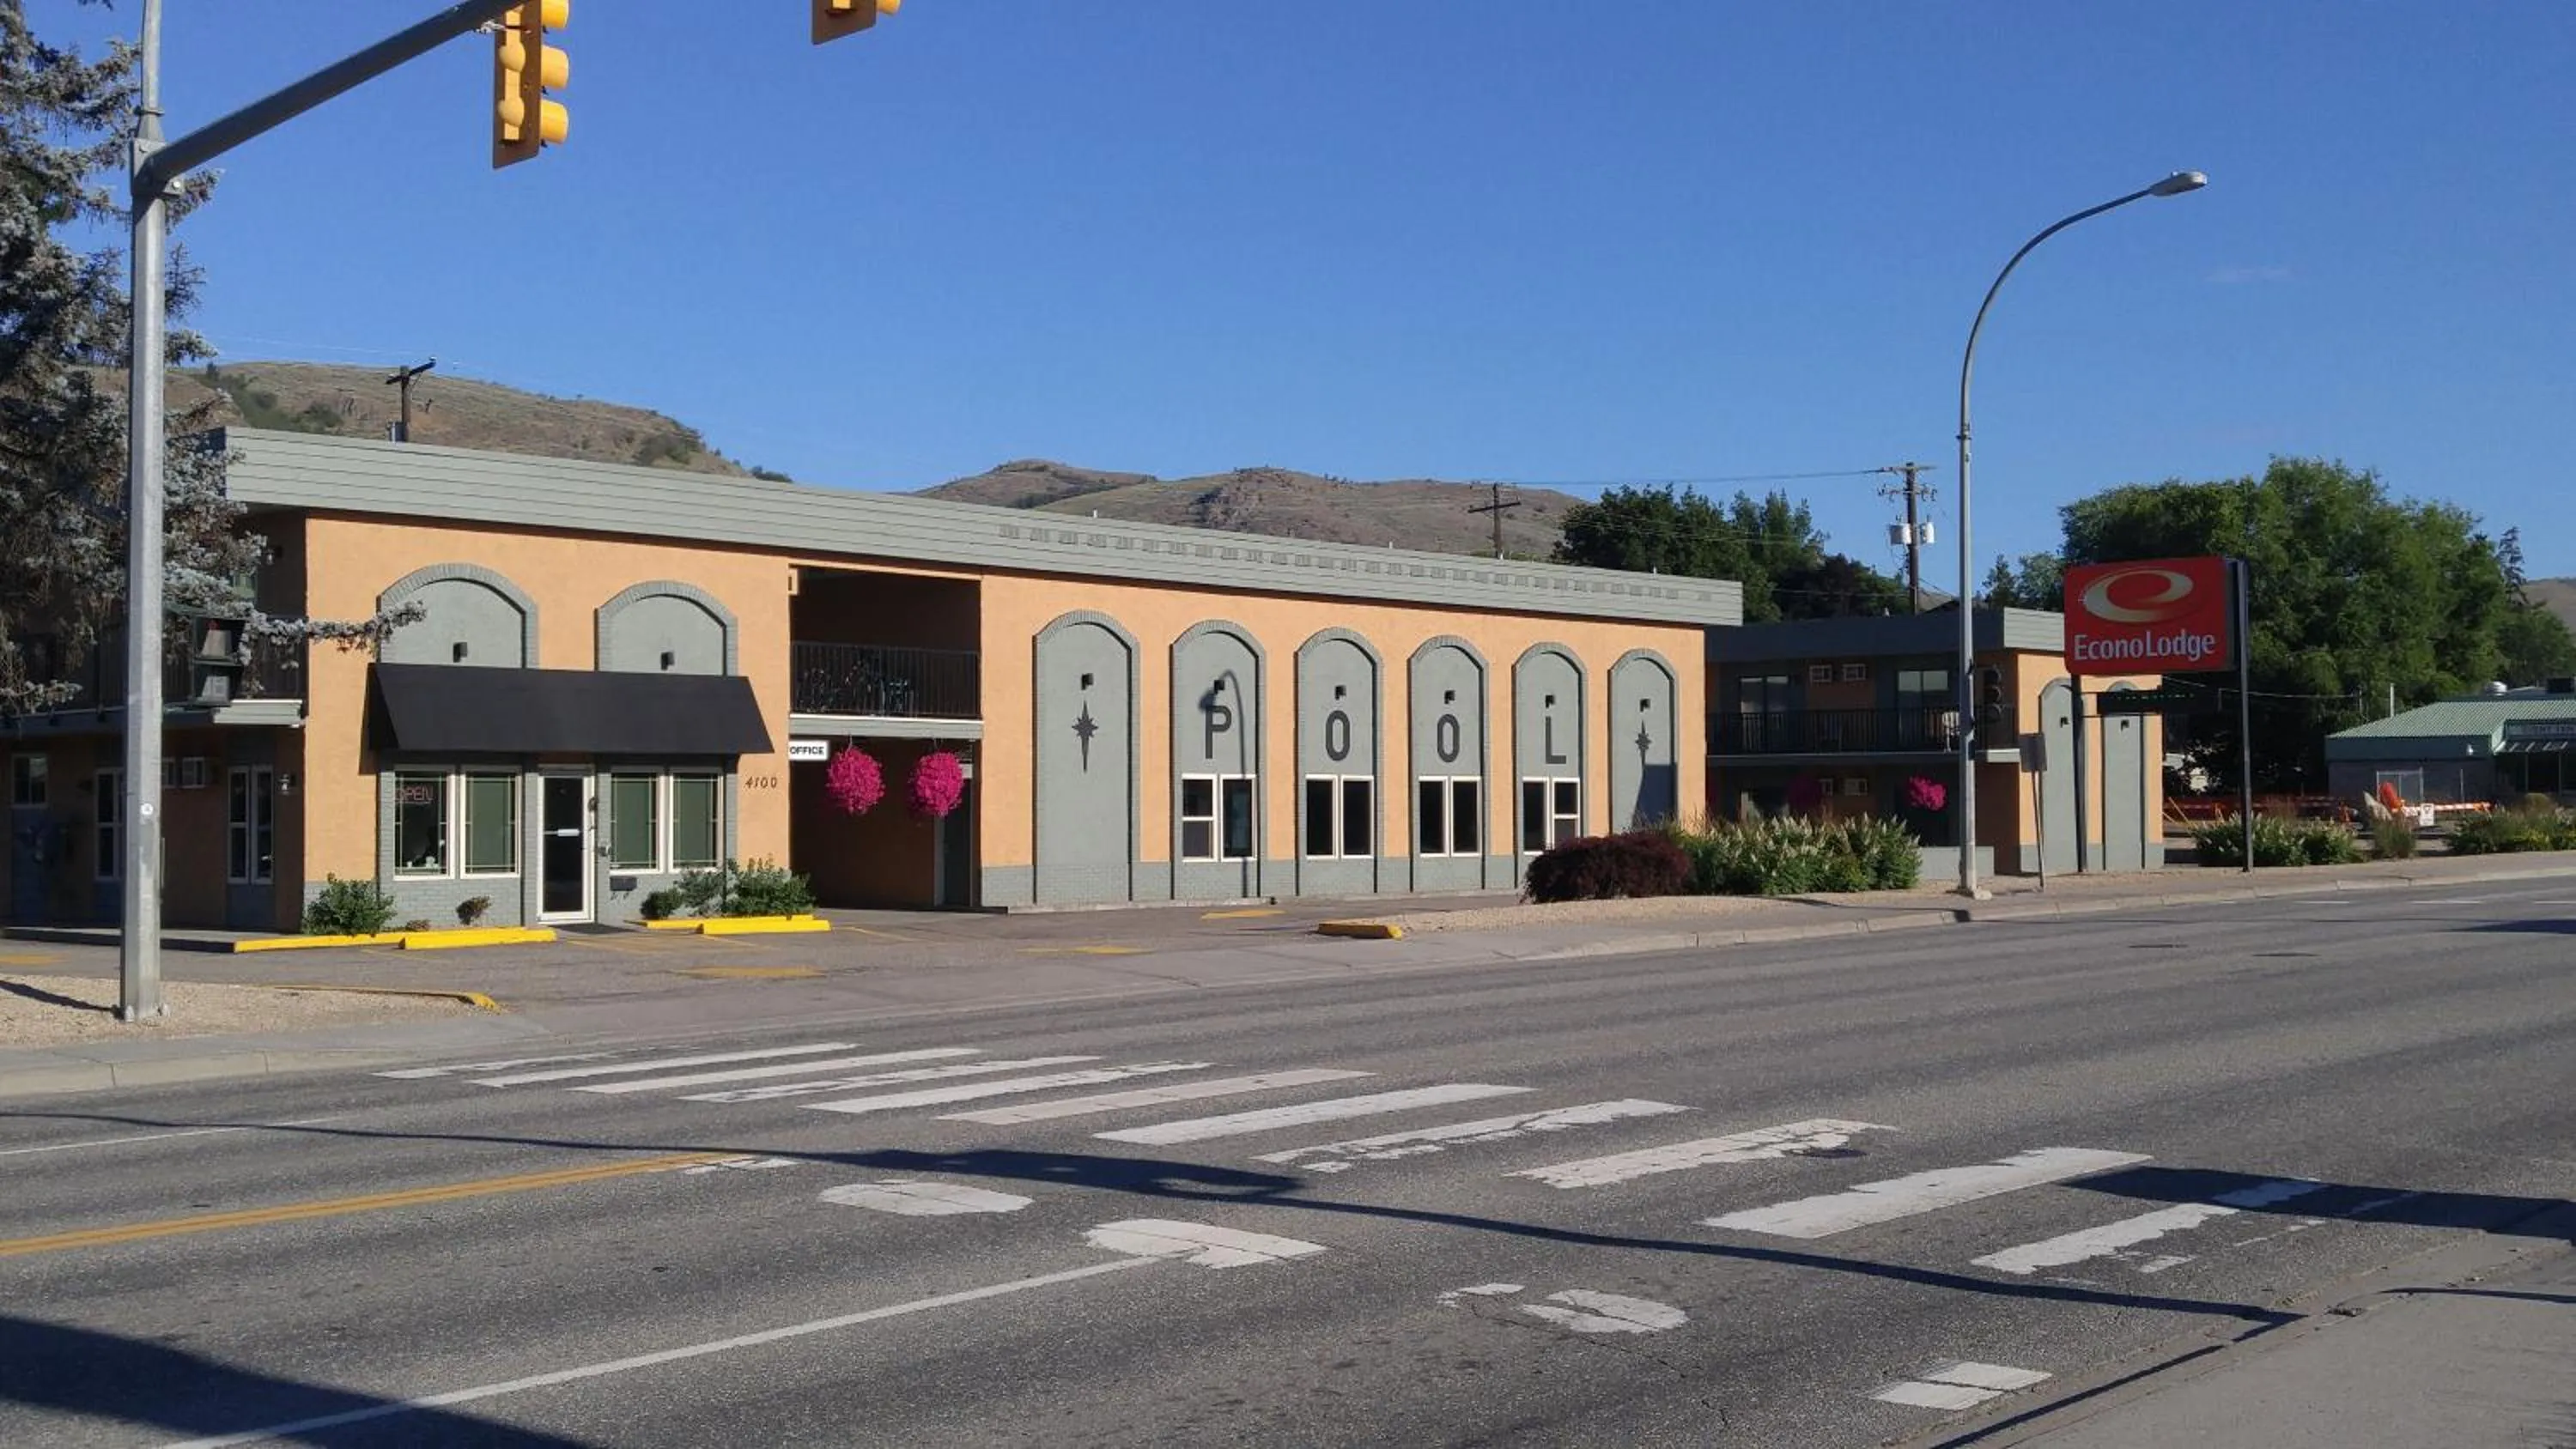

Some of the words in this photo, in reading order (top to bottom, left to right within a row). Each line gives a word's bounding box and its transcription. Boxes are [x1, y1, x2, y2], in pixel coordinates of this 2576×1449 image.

[2074, 629, 2215, 661] EconoLodge
[789, 746, 825, 755] OFFICE
[745, 776, 777, 789] 4100
